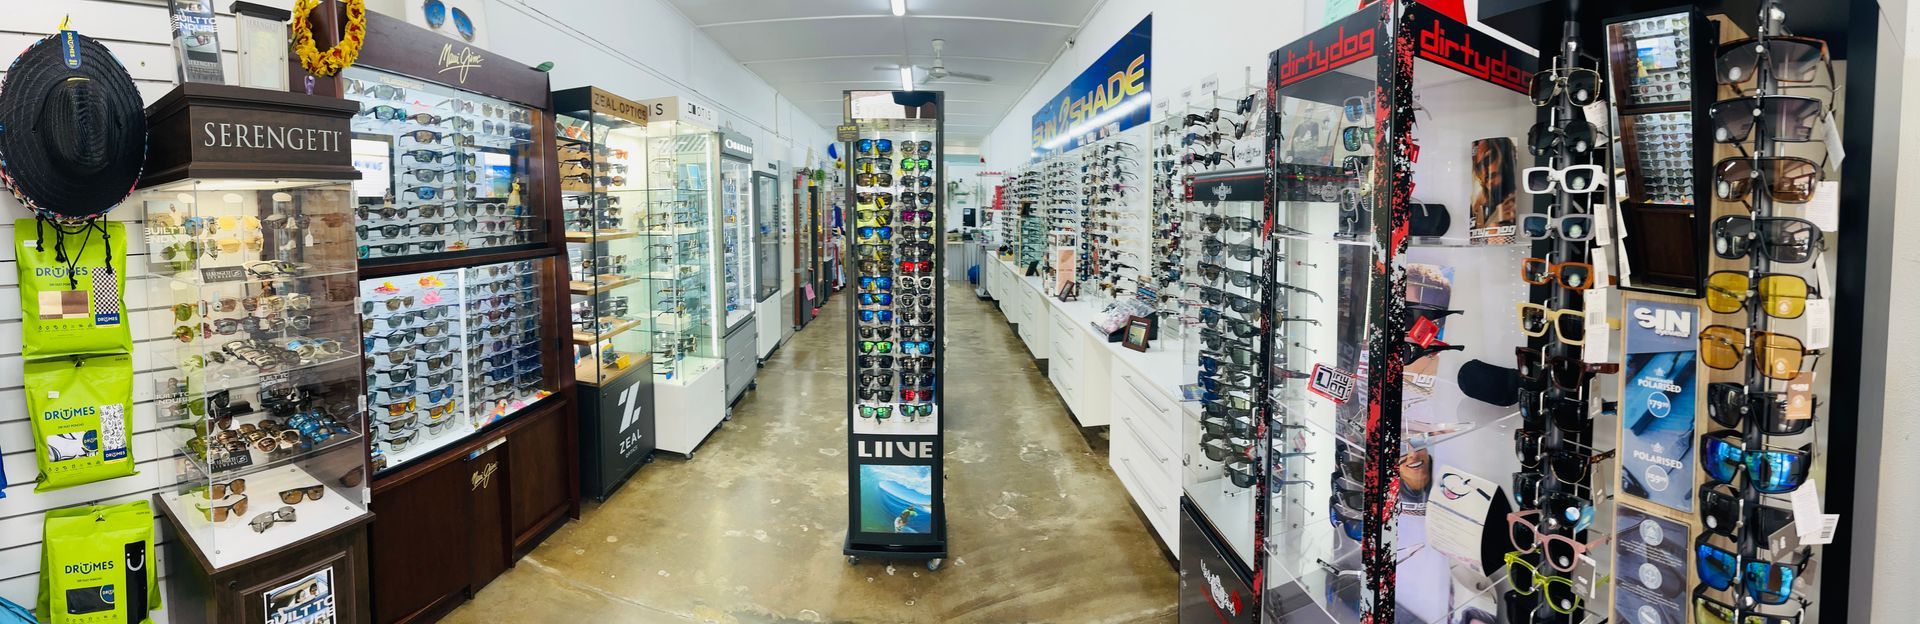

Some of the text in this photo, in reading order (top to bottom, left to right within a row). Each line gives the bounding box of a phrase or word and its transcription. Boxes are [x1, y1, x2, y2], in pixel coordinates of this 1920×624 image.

[1069, 53, 1145, 127] SHADE
[594, 93, 648, 121] ZEAL OPTICS
[204, 121, 340, 152] SERENGETI
[1633, 307, 1691, 335] SIN
[1637, 378, 1682, 394] POLARISED
[619, 429, 642, 455] ZEAL
[857, 440, 933, 459] LIIVE
[1633, 449, 1684, 470] POLARISED
